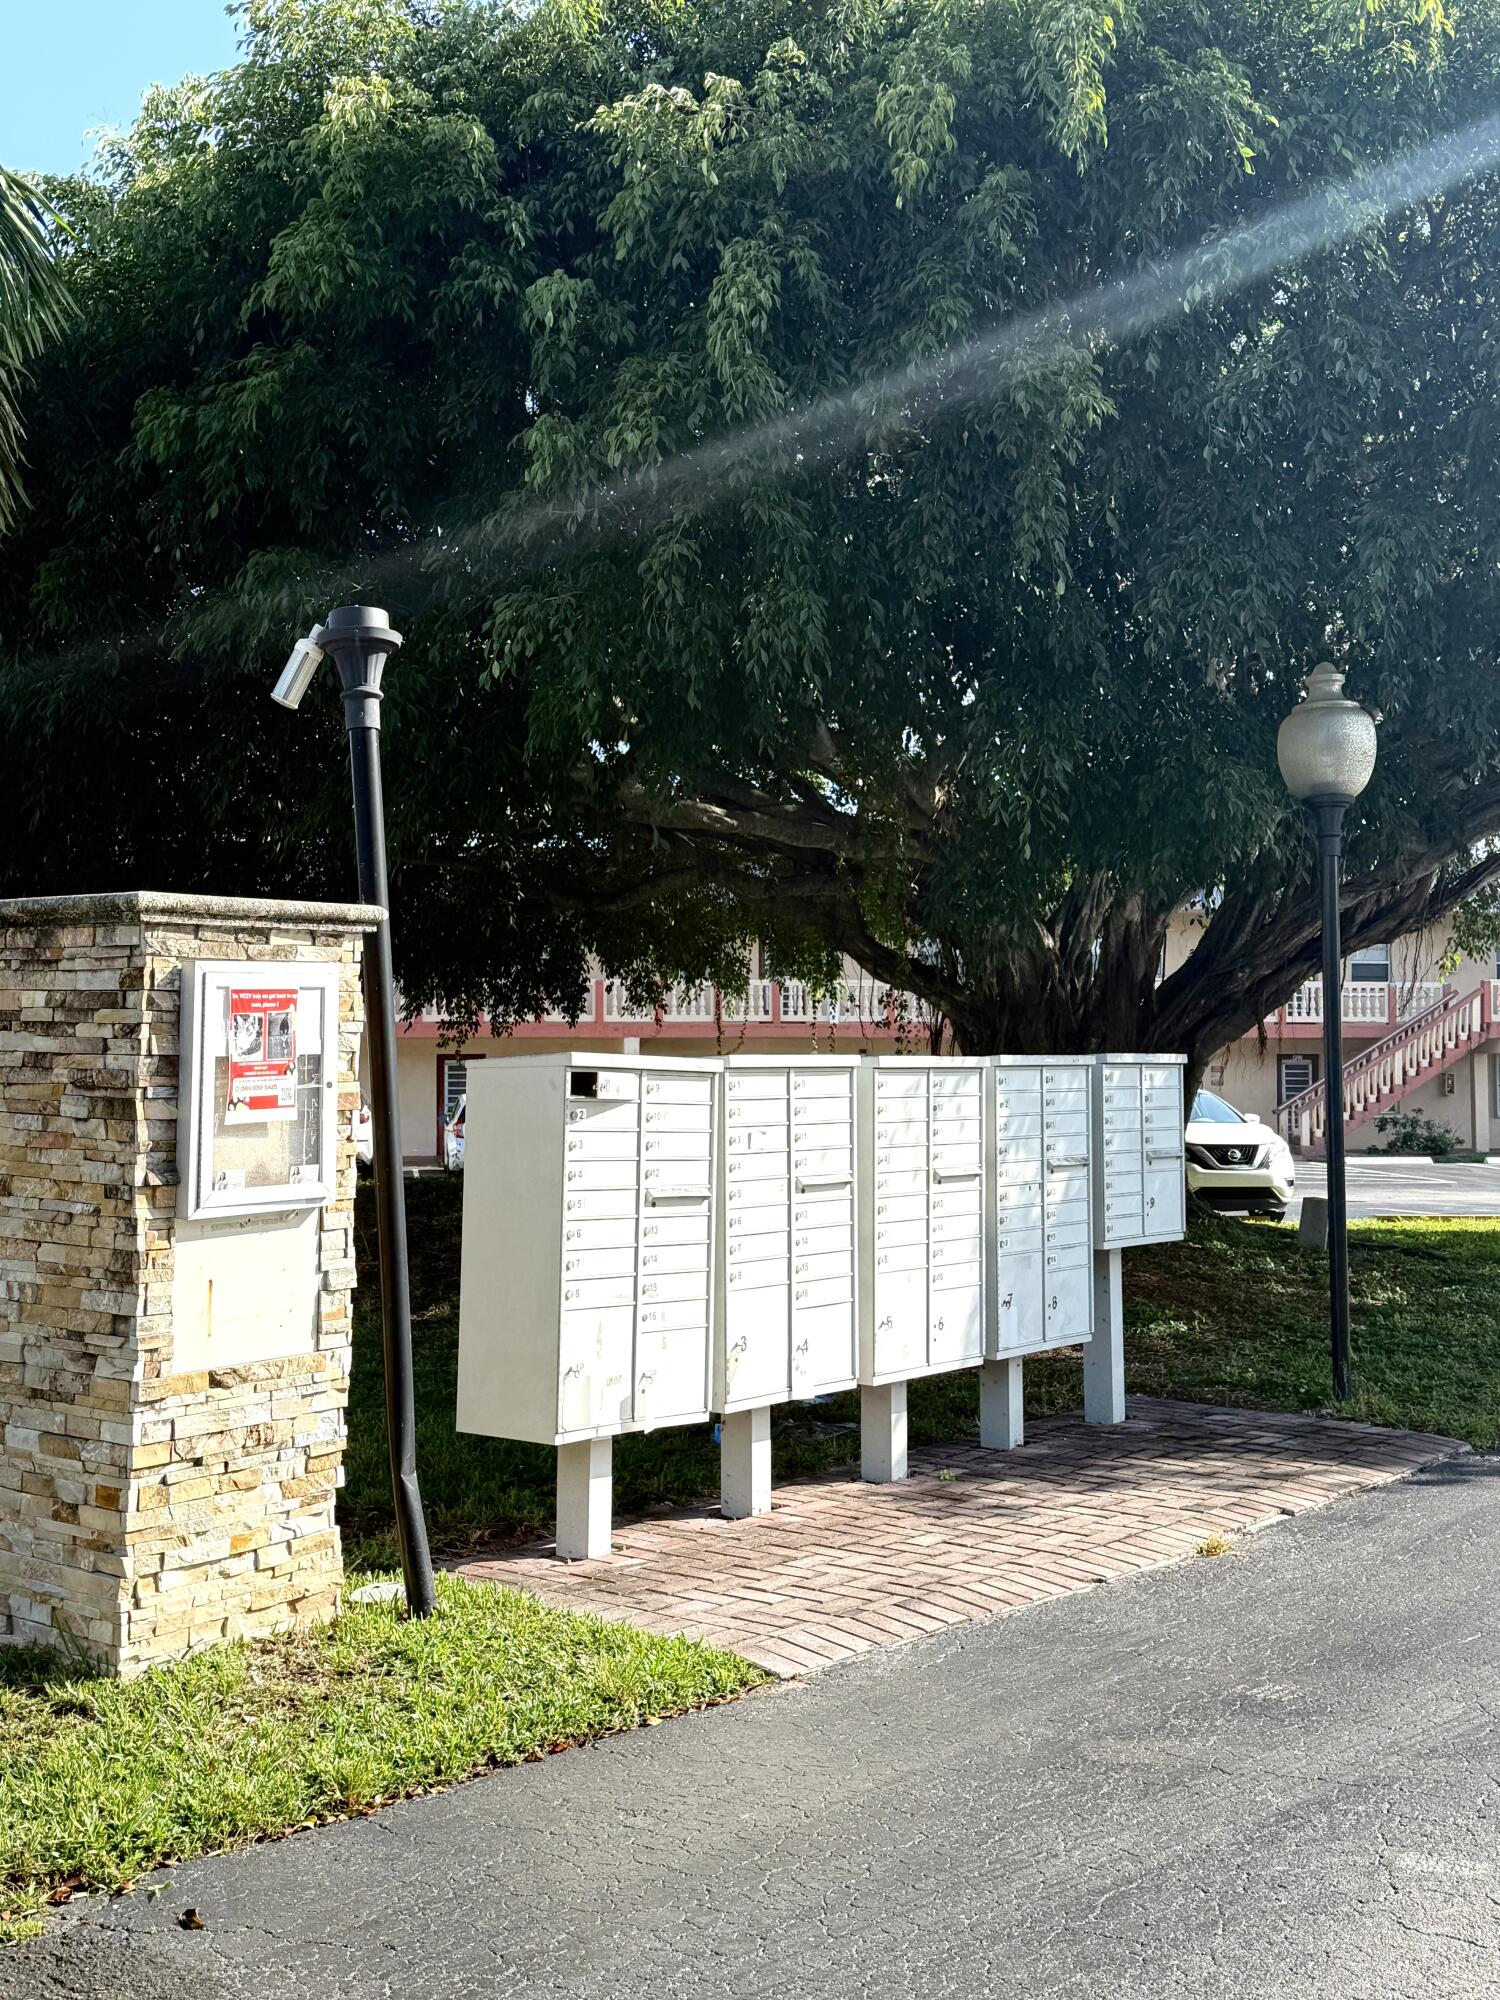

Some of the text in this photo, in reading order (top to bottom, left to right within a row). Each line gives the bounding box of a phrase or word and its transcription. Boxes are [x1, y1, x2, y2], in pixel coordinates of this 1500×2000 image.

[655, 1084, 660, 1092] 9
[579, 1111, 584, 1120] 2
[578, 1141, 583, 1149] 3
[652, 1169, 660, 1177] 12
[1150, 1197, 1155, 1208] 9
[576, 1230, 581, 1238] 6
[737, 1244, 741, 1252] 7
[576, 1259, 580, 1267] 7
[1006, 1293, 1013, 1310] 7
[1052, 1296, 1057, 1309] 8
[886, 1316, 893, 1328] 5
[938, 1317, 944, 1330] 6
[740, 1336, 747, 1352] 3
[803, 1339, 808, 1353] 4
